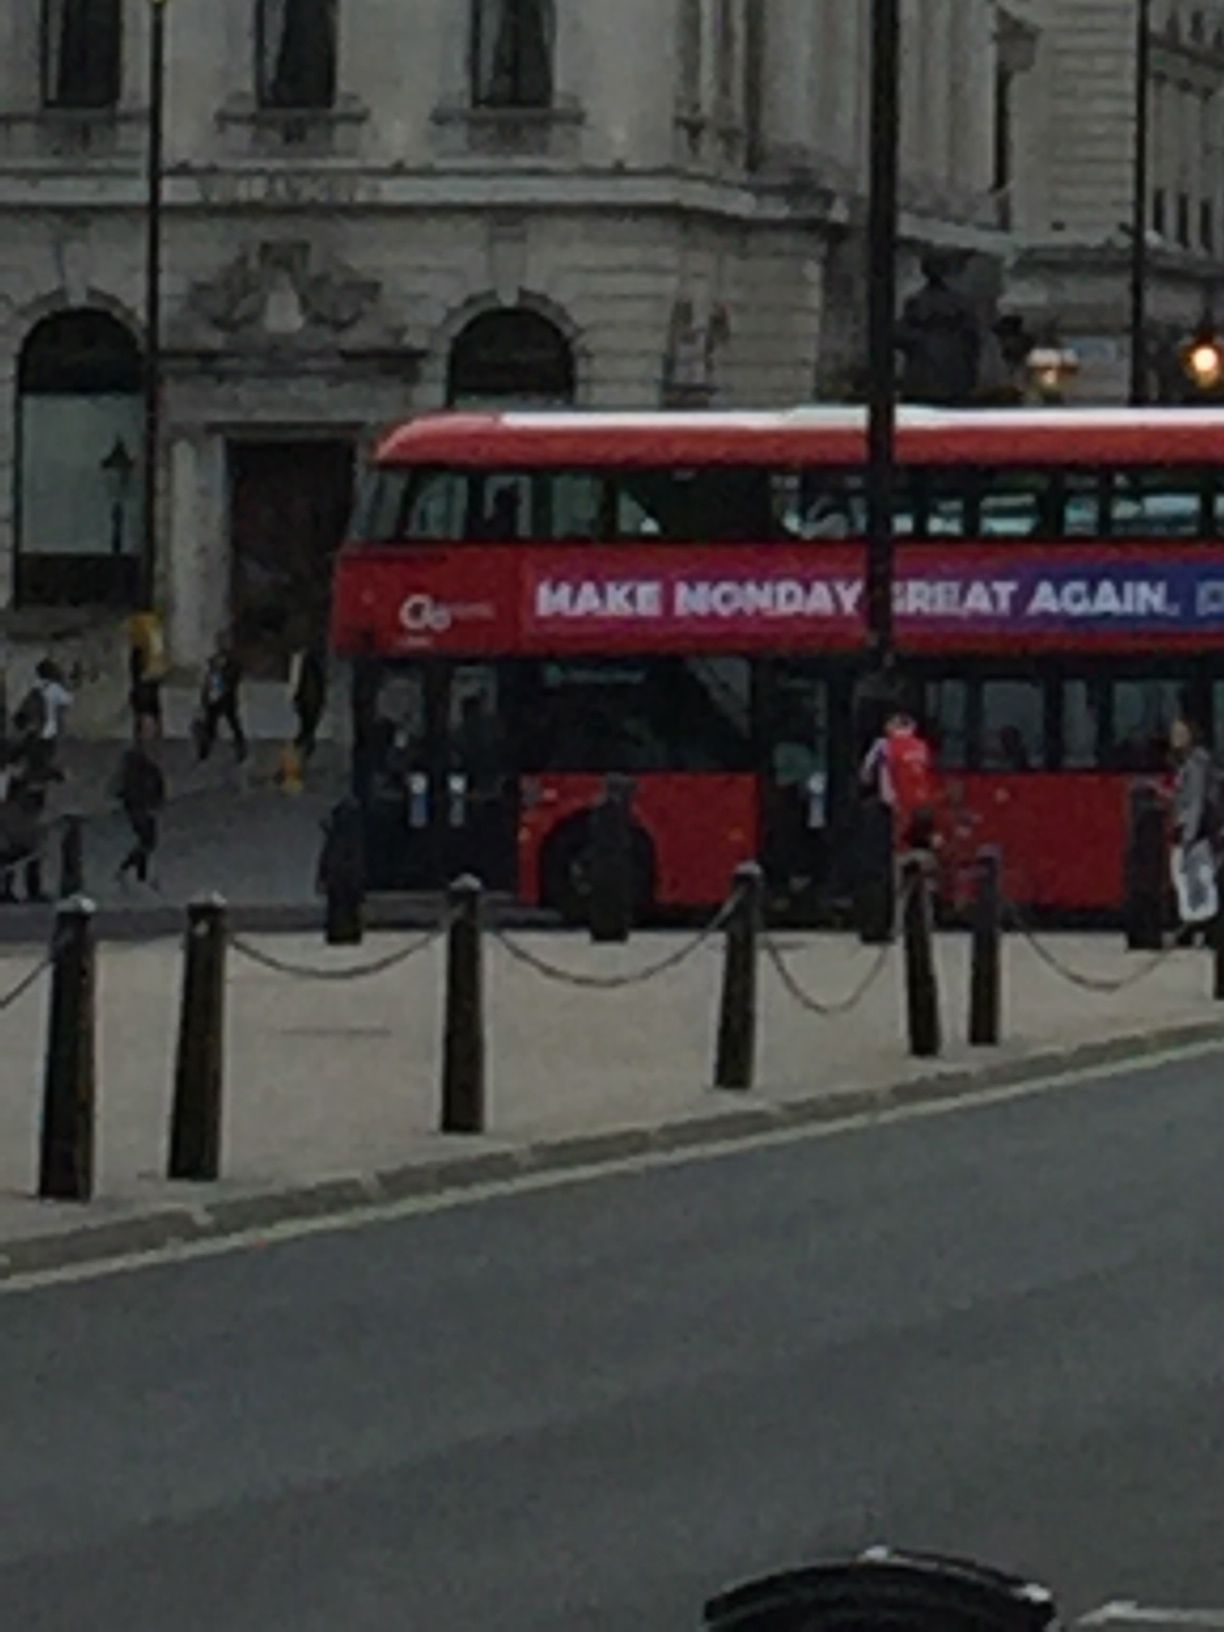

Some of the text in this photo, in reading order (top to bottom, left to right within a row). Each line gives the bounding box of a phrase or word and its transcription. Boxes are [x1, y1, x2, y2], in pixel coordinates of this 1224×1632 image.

[536, 580, 662, 617] MAKE
[674, 580, 863, 617] MONDAY
[1026, 579, 1180, 617] AGAIN.
